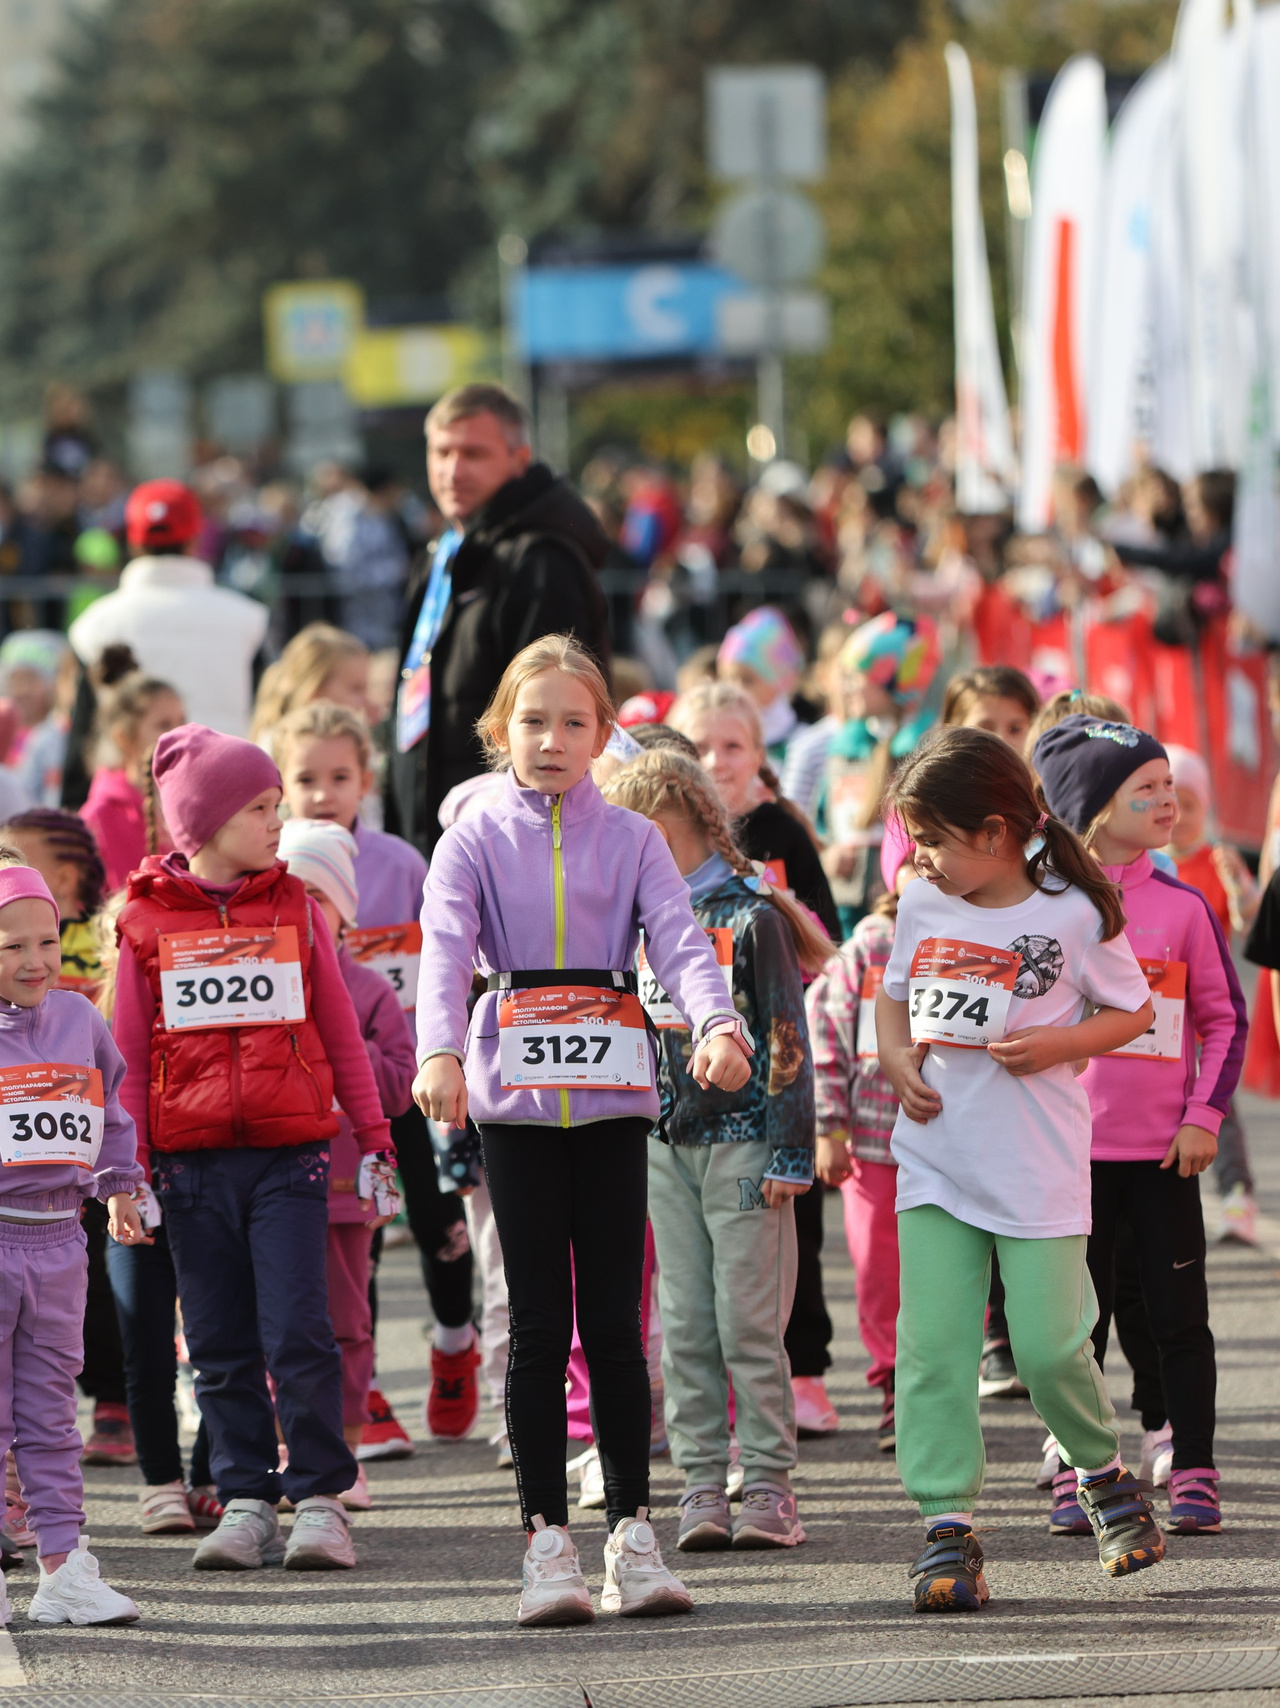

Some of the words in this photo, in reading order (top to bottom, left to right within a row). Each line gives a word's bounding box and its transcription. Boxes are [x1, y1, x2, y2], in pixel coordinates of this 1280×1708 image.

[176, 975, 274, 1007] 3020
[911, 988, 990, 1027] 3274
[522, 1035, 612, 1065] 3127
[9, 1112, 92, 1144] 3062
